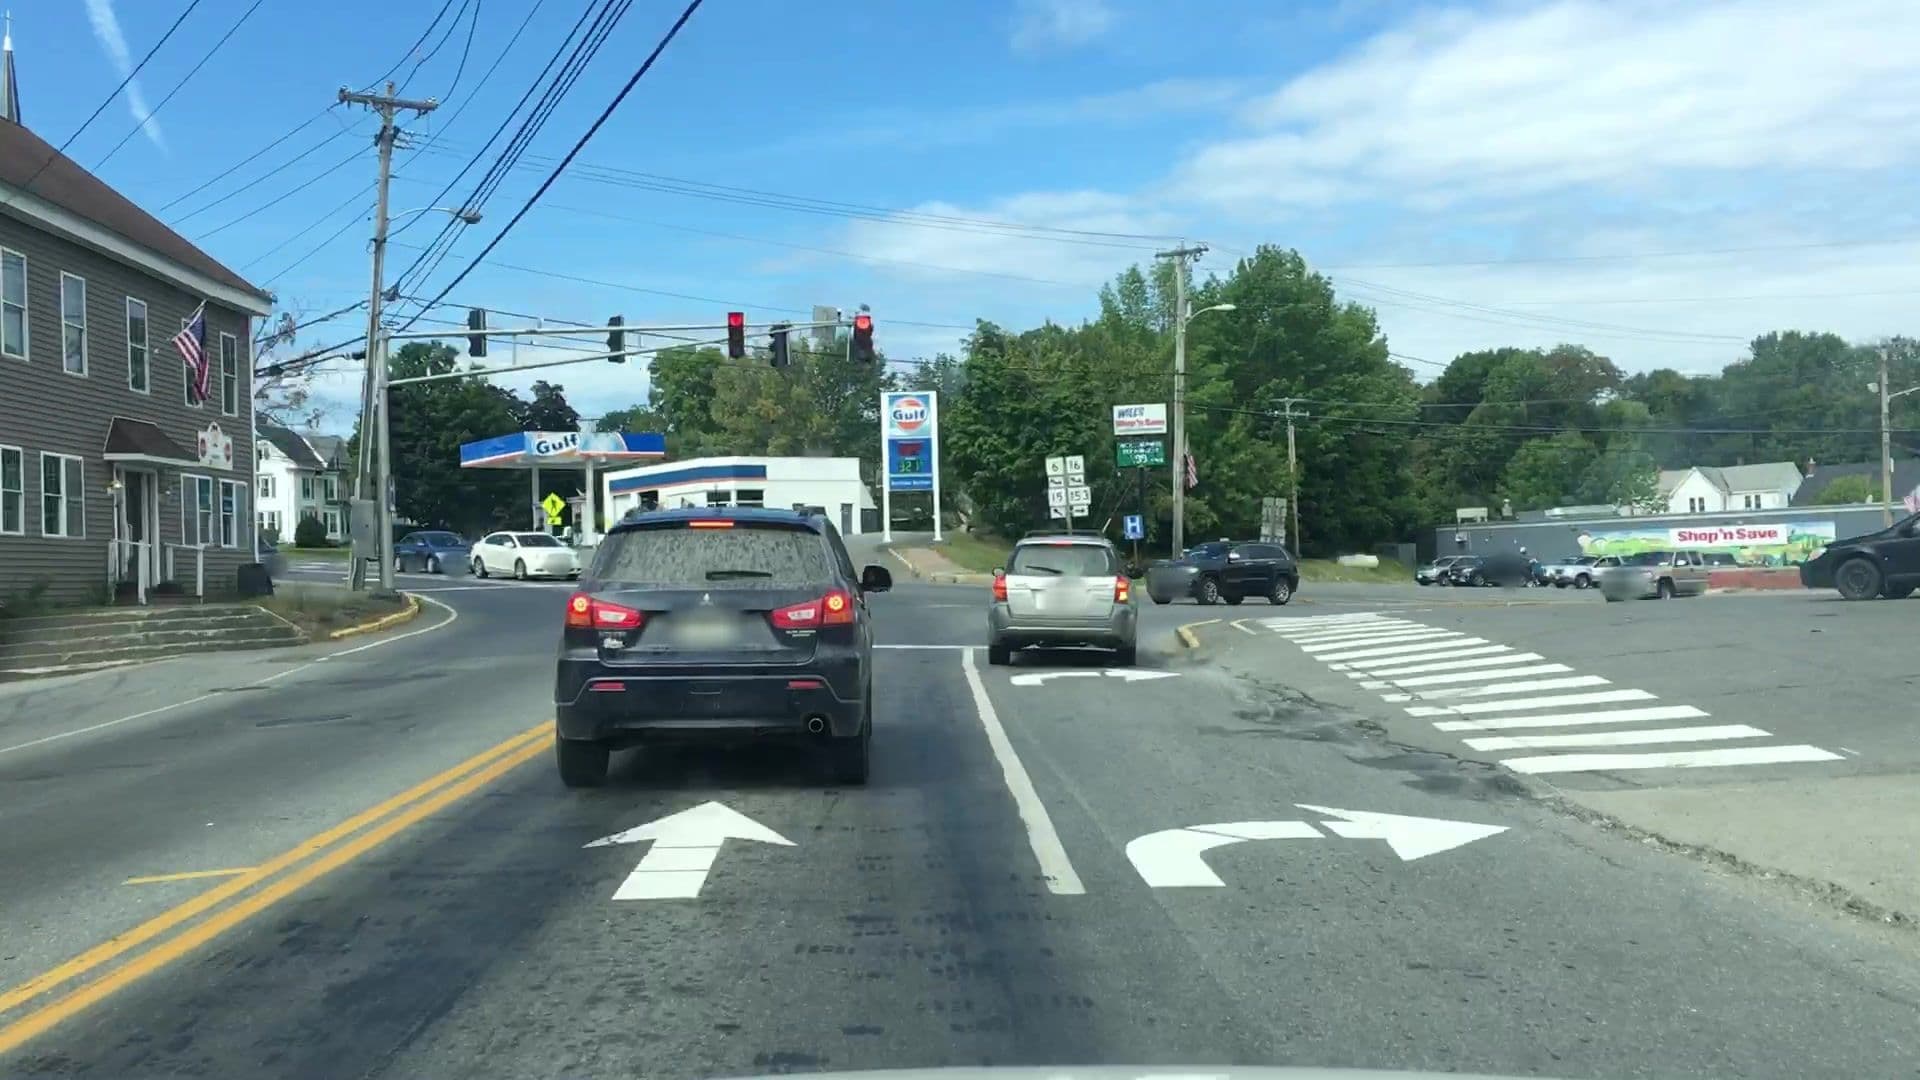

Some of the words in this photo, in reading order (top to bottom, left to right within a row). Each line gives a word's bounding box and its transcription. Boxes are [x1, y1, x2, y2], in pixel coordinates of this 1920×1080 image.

[893, 409, 925, 420] Gulf
[536, 433, 577, 454] Gulf
[1052, 463, 1059, 472] 6
[1069, 460, 1081, 471] 16
[1052, 492, 1063, 502] 15
[1070, 489, 1089, 501] 153
[1127, 516, 1140, 533] H
[1736, 528, 1778, 540] Save
